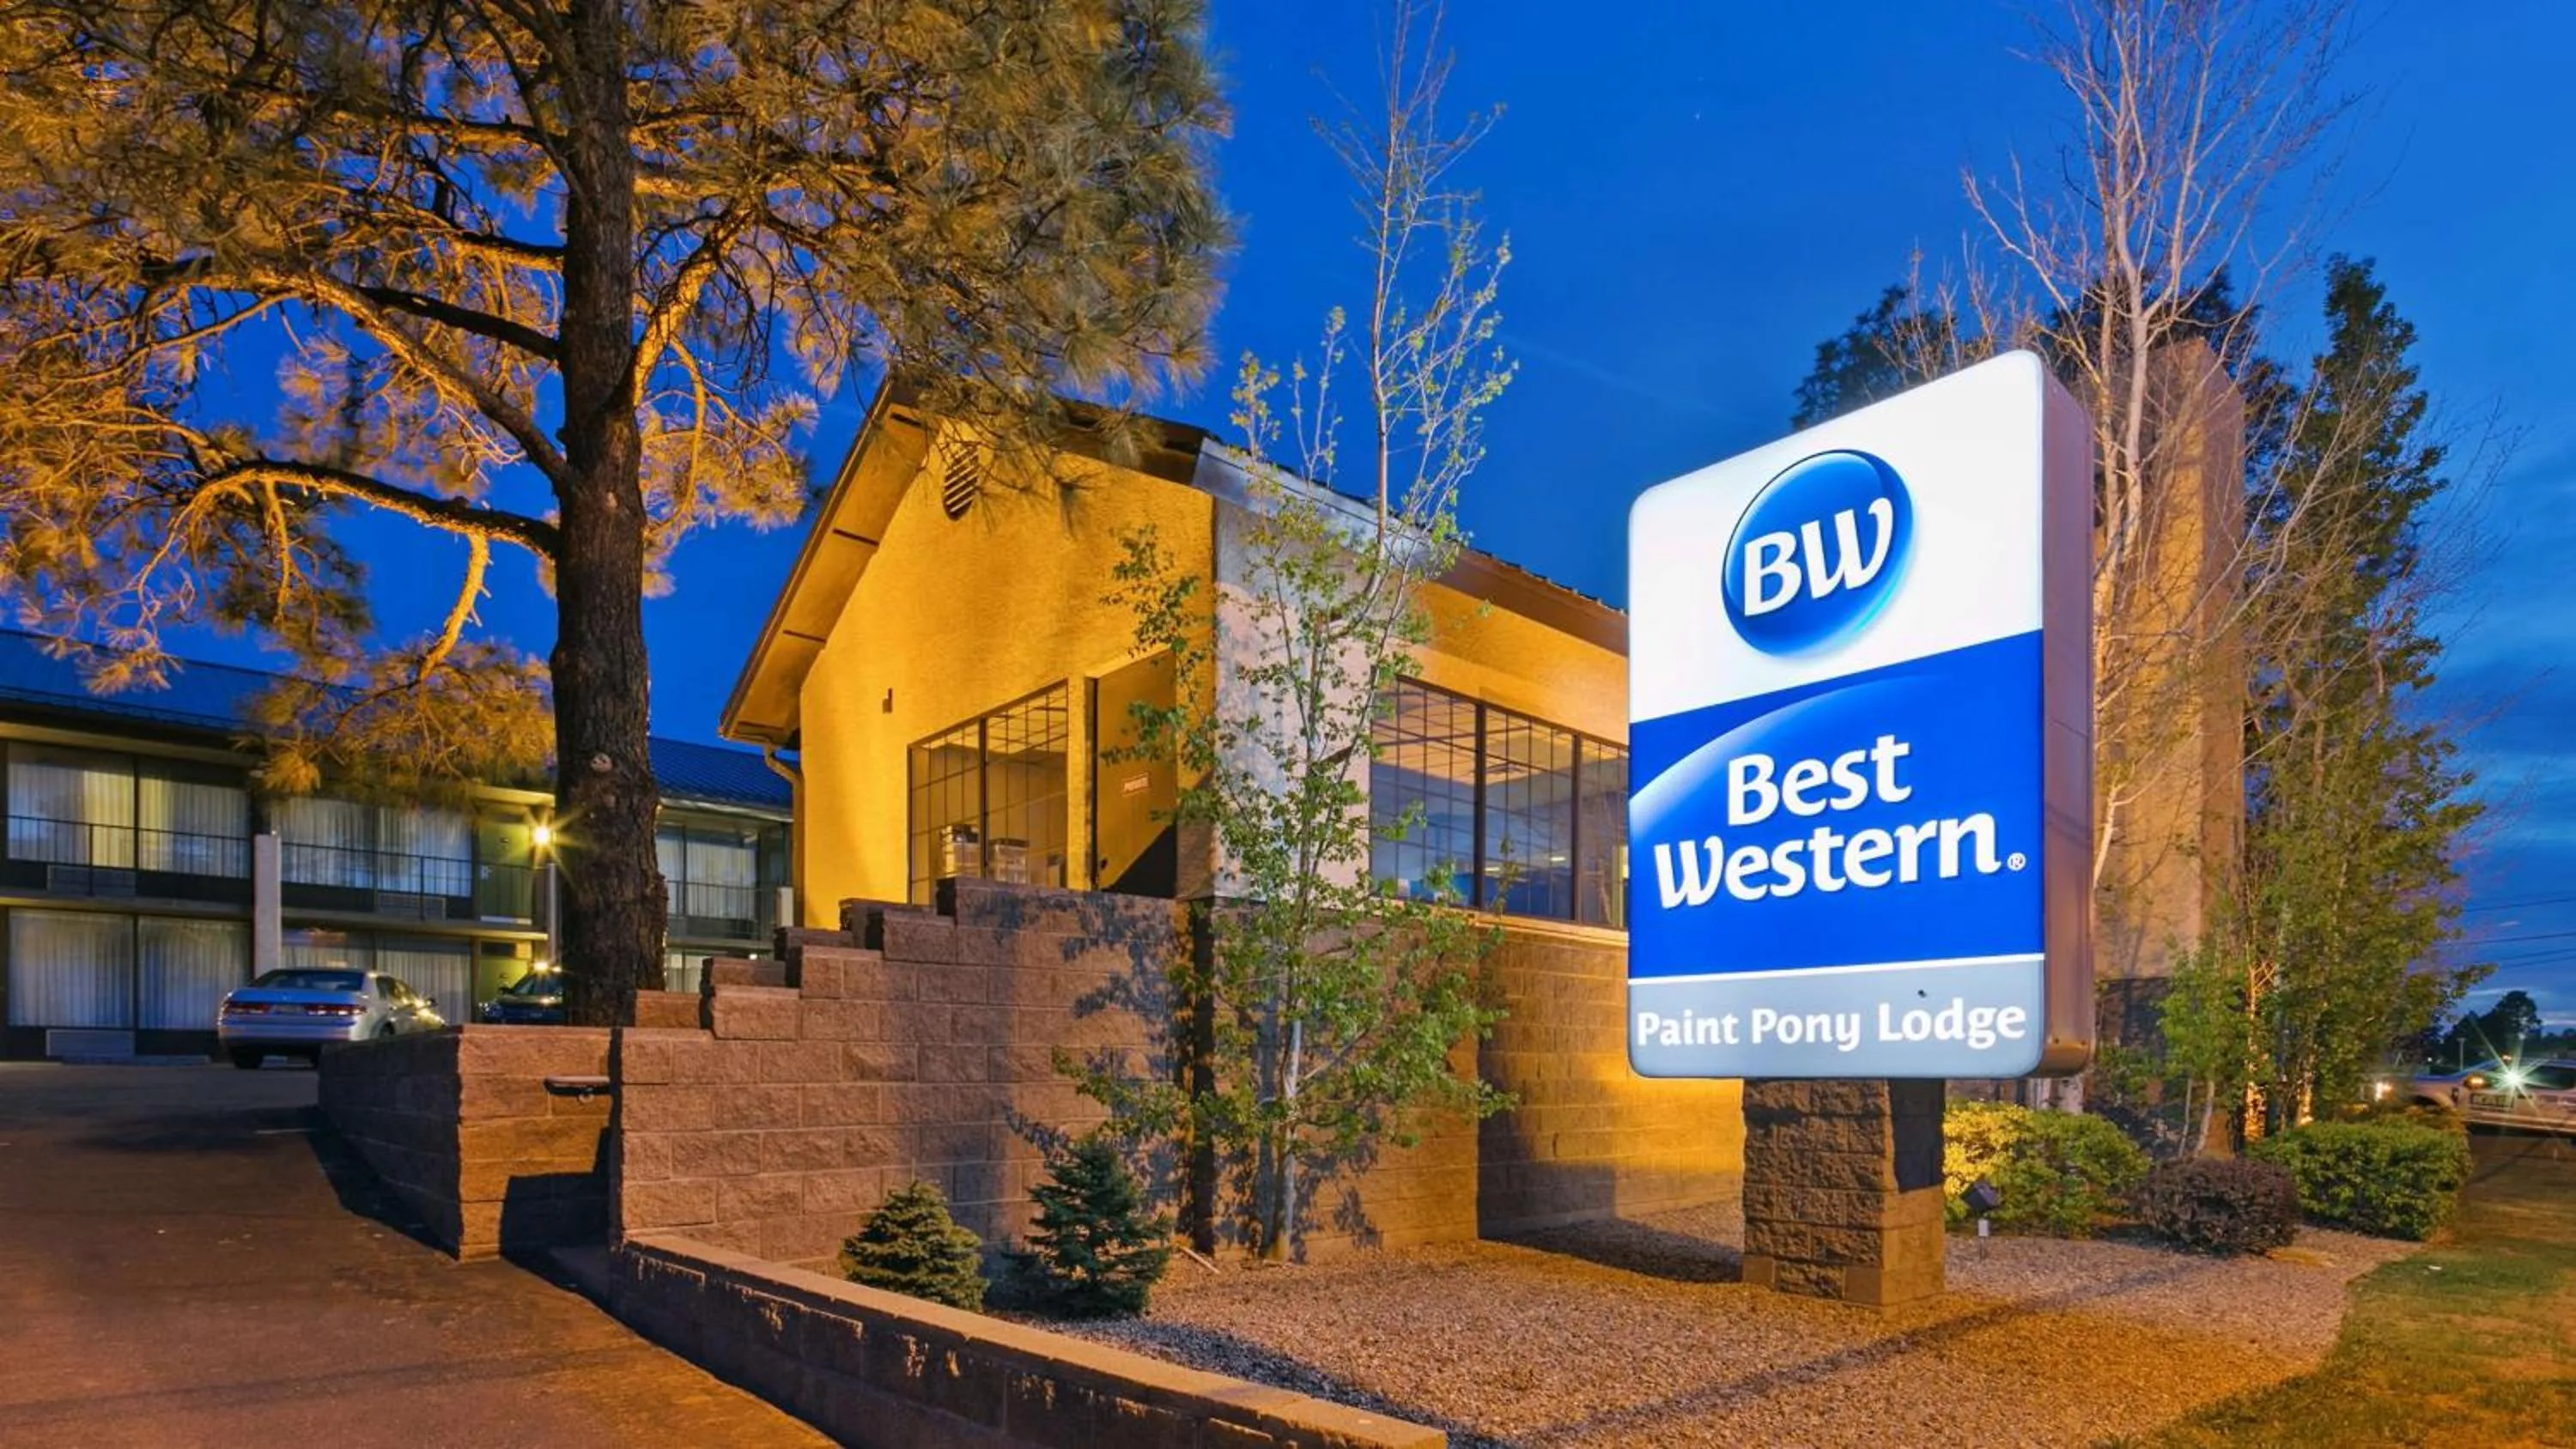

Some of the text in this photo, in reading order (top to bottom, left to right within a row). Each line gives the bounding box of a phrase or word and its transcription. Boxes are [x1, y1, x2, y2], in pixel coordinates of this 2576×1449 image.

[1744, 497, 1893, 616] BW
[1727, 734, 1911, 826] Best
[1637, 997, 2026, 1052] Paint Pony Lodge
